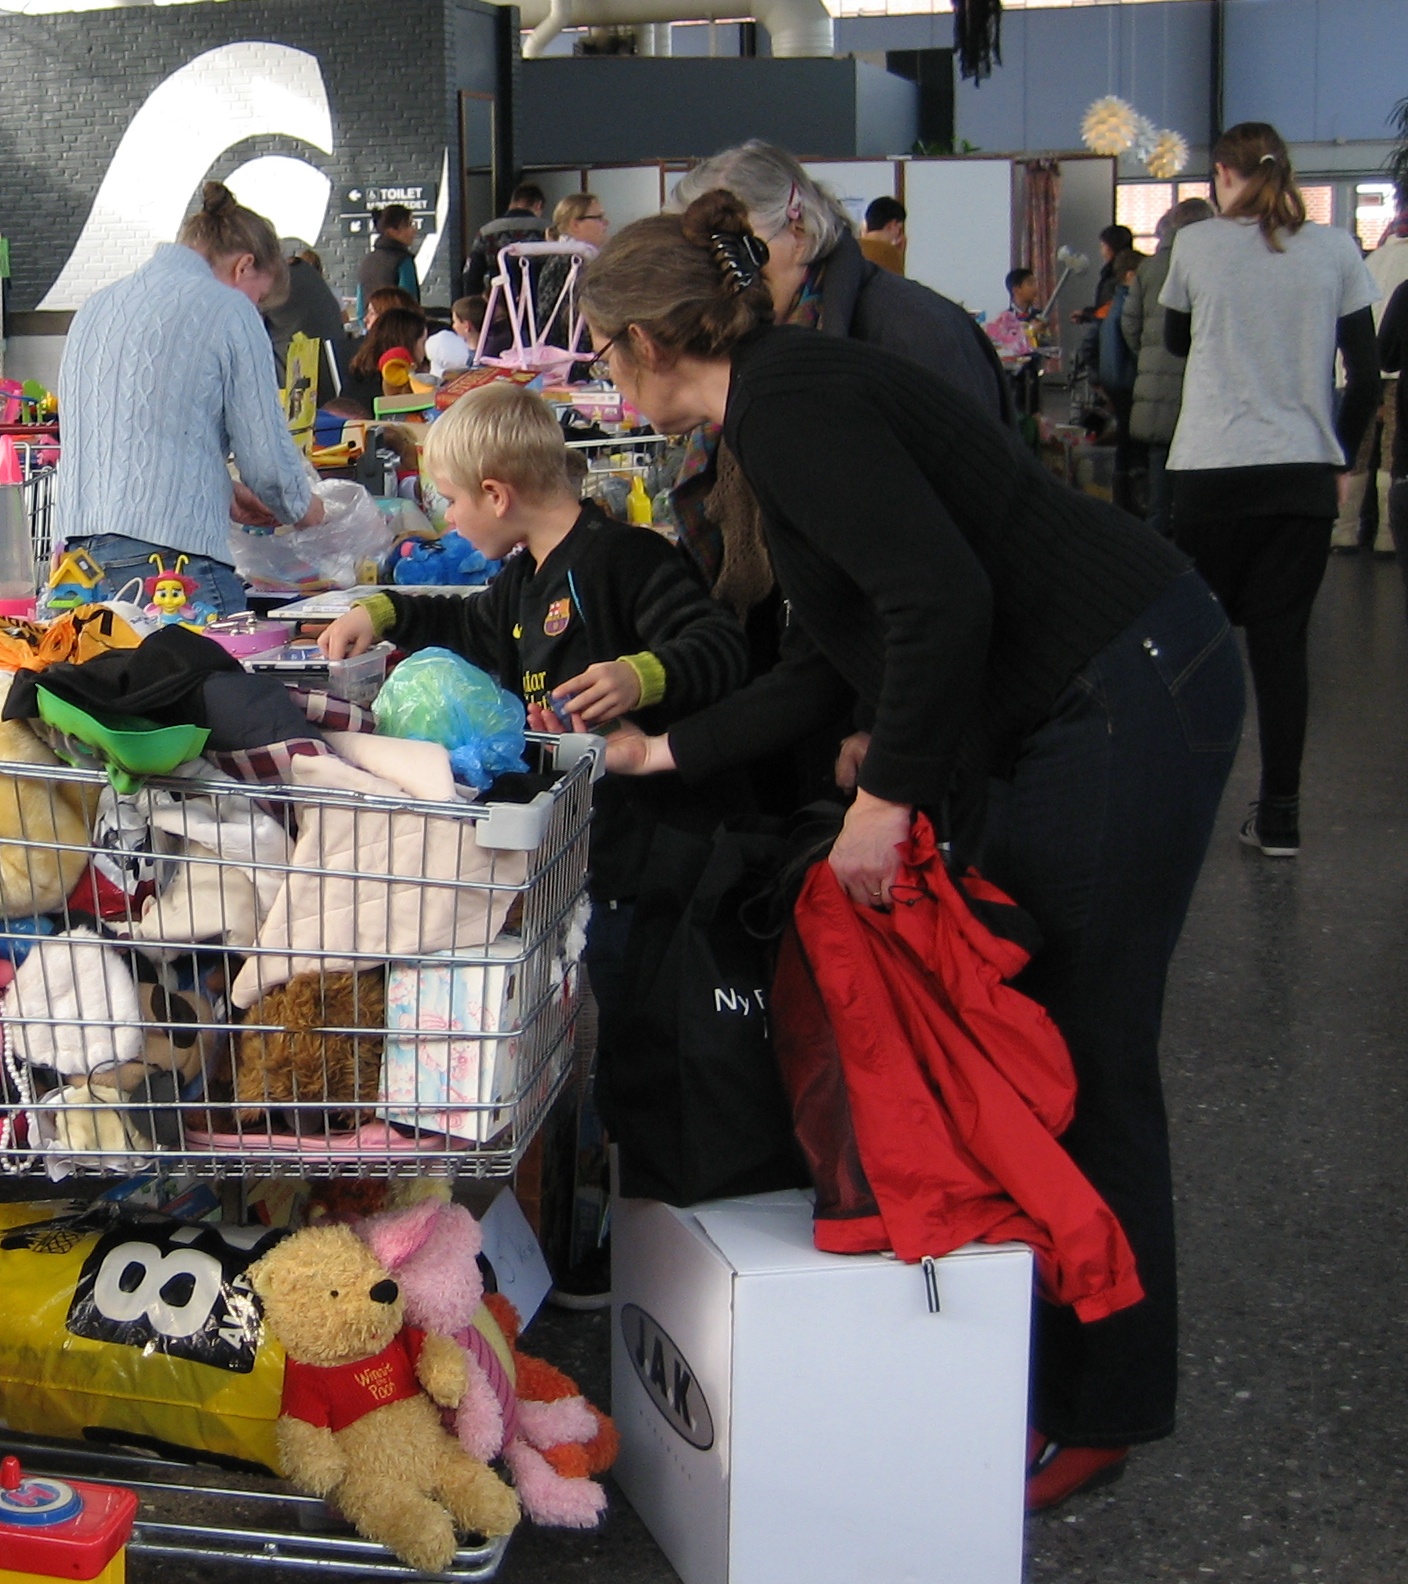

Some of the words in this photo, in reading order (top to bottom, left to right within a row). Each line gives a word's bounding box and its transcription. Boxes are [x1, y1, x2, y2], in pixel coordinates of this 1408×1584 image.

[380, 187, 423, 200] TOILET
[714, 986, 749, 1016] Ny
[354, 1362, 393, 1387] Winnie
[368, 1381, 396, 1400] Pooh
